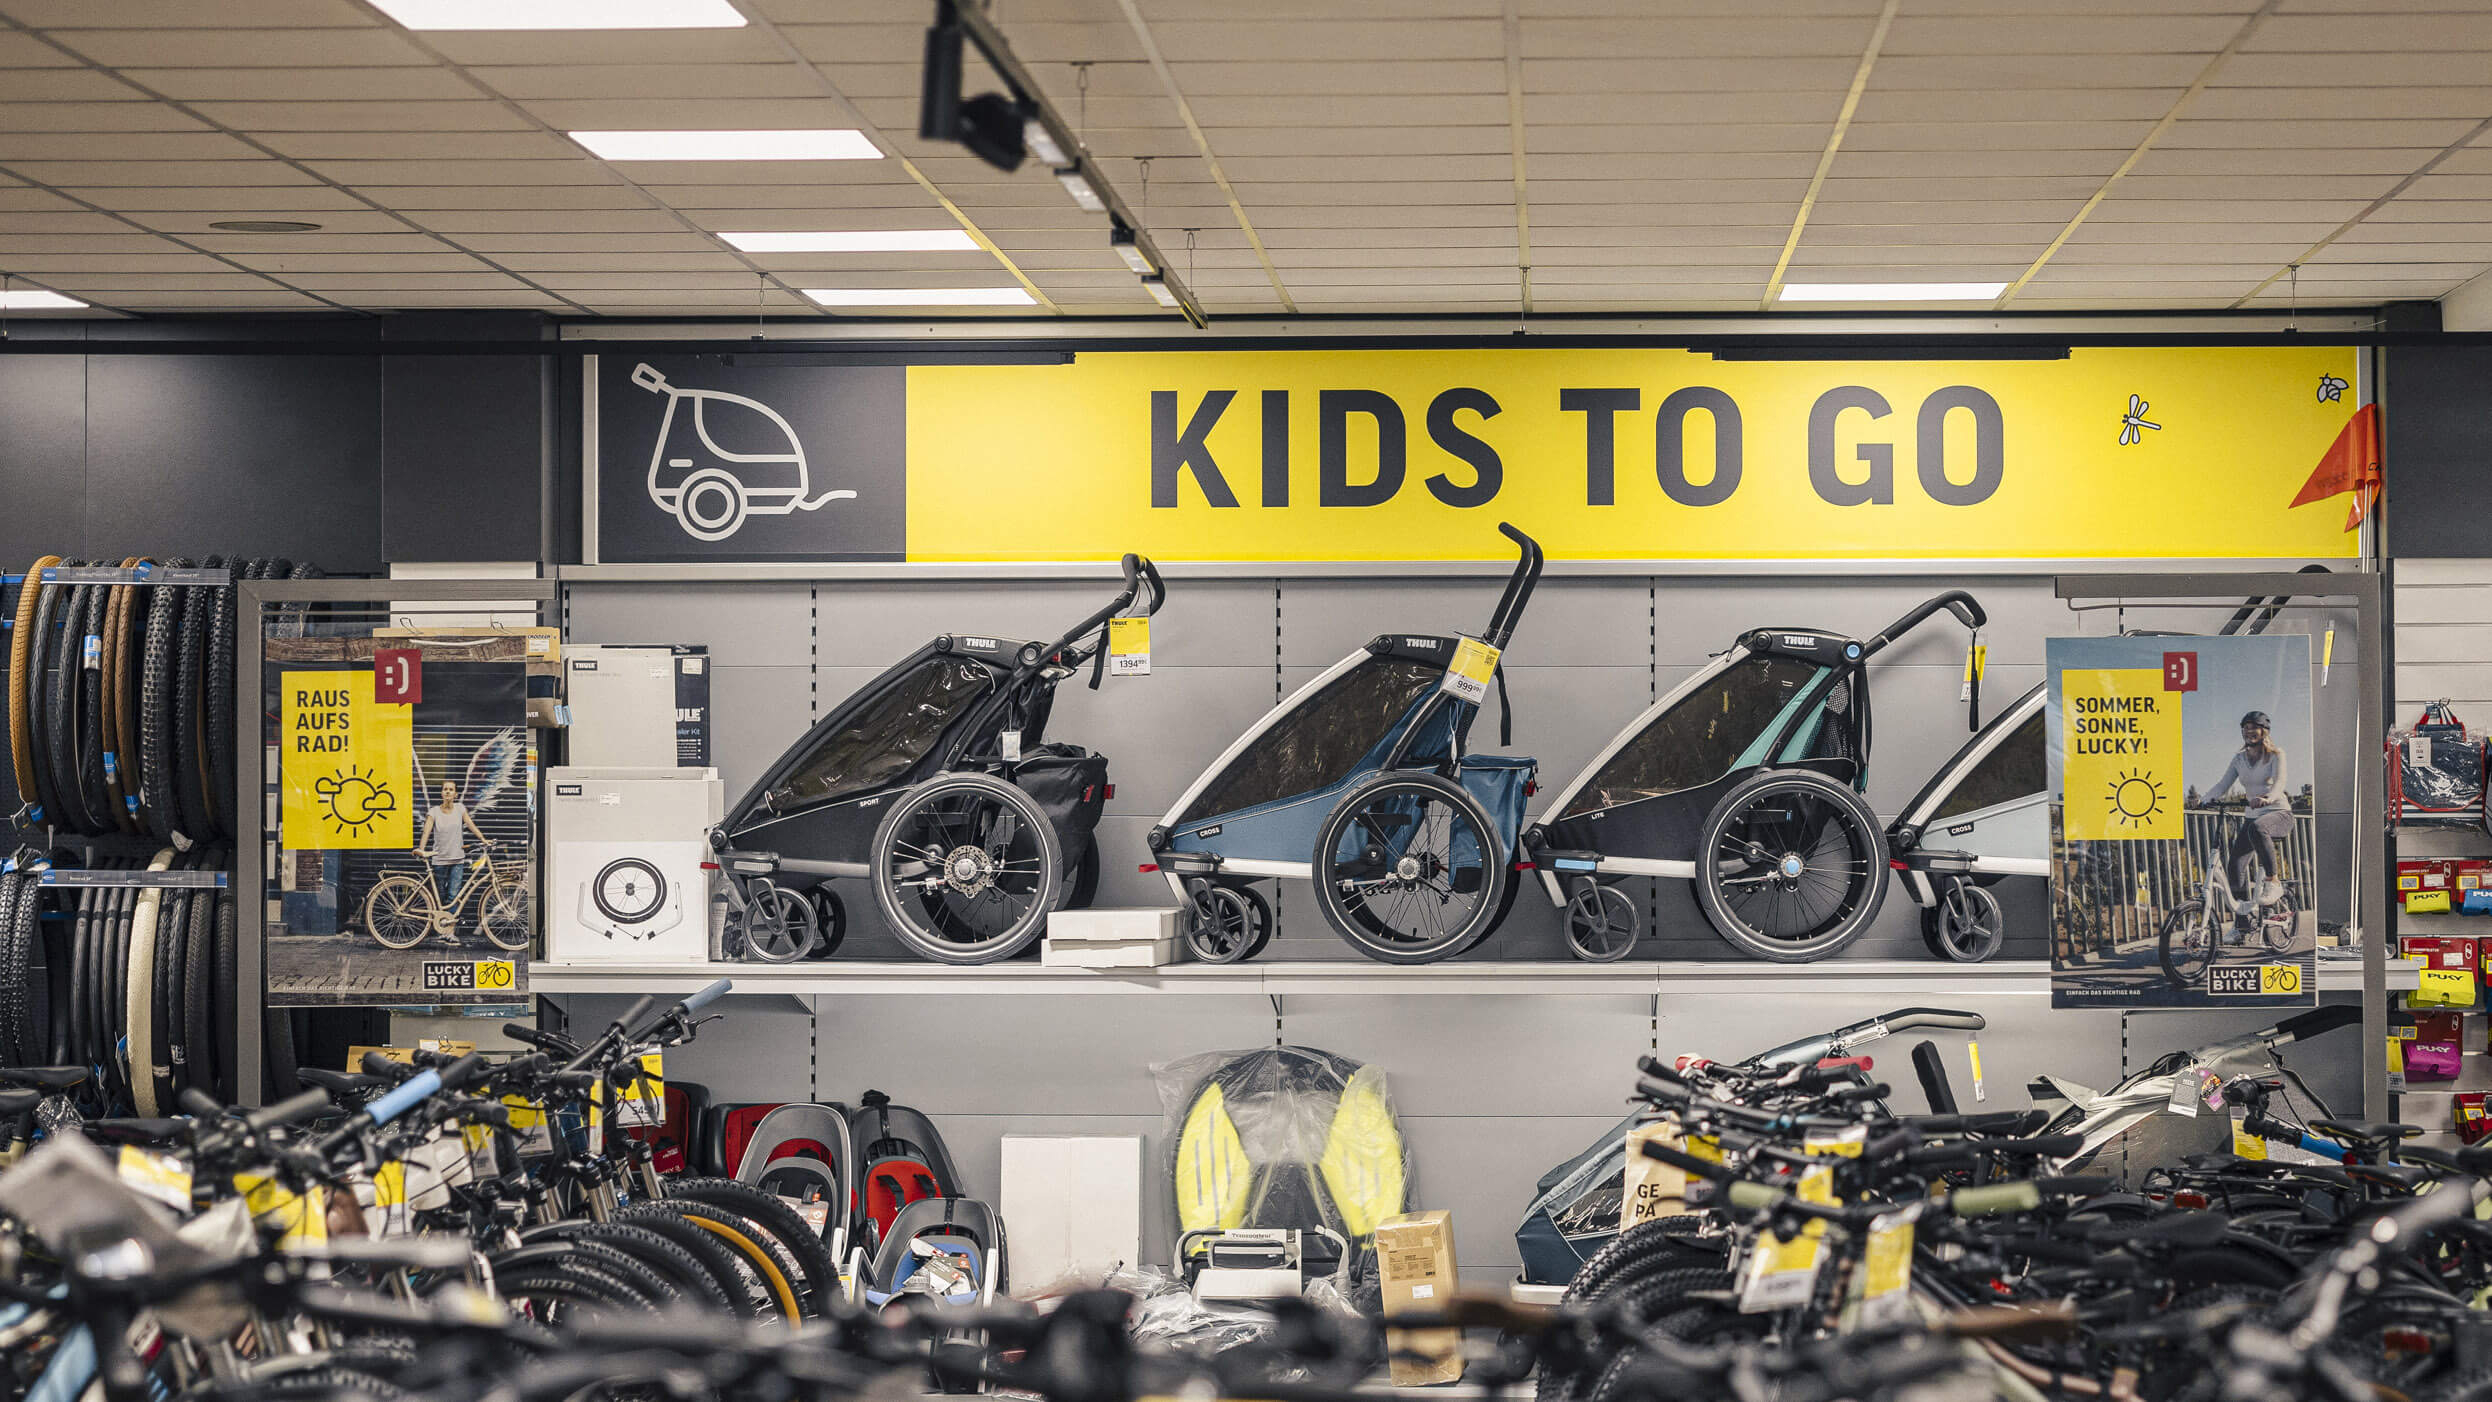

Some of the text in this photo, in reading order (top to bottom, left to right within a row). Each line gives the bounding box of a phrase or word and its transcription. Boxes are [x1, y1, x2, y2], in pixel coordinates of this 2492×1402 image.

[1151, 386, 2004, 509] KIDS TO GO
[966, 637, 996, 648] THULE
[1406, 638, 1437, 649] THULE
[1783, 635, 1815, 646] THULE
[575, 662, 596, 670] THULE
[296, 690, 350, 708] RAUS
[2075, 697, 2160, 714] SOMMER,
[676, 708, 700, 721] ULE
[296, 713, 350, 730] AUFS
[2076, 718, 2144, 735] SONNE,
[297, 735, 349, 752] RAD!
[2077, 738, 2148, 754] LUCKY!
[860, 798, 880, 807] SPORT
[1200, 826, 1220, 837] CROSS
[1951, 824, 1972, 834] CROSS
[428, 965, 471, 975] LUCKY
[2212, 969, 2257, 980] LUCKY
[428, 975, 471, 987] BIKE
[2427, 973, 2463, 981] PUKY
[2212, 979, 2257, 991] BIKE
[2416, 1045, 2451, 1053] PUKY
[1637, 1183, 1660, 1198] GE
